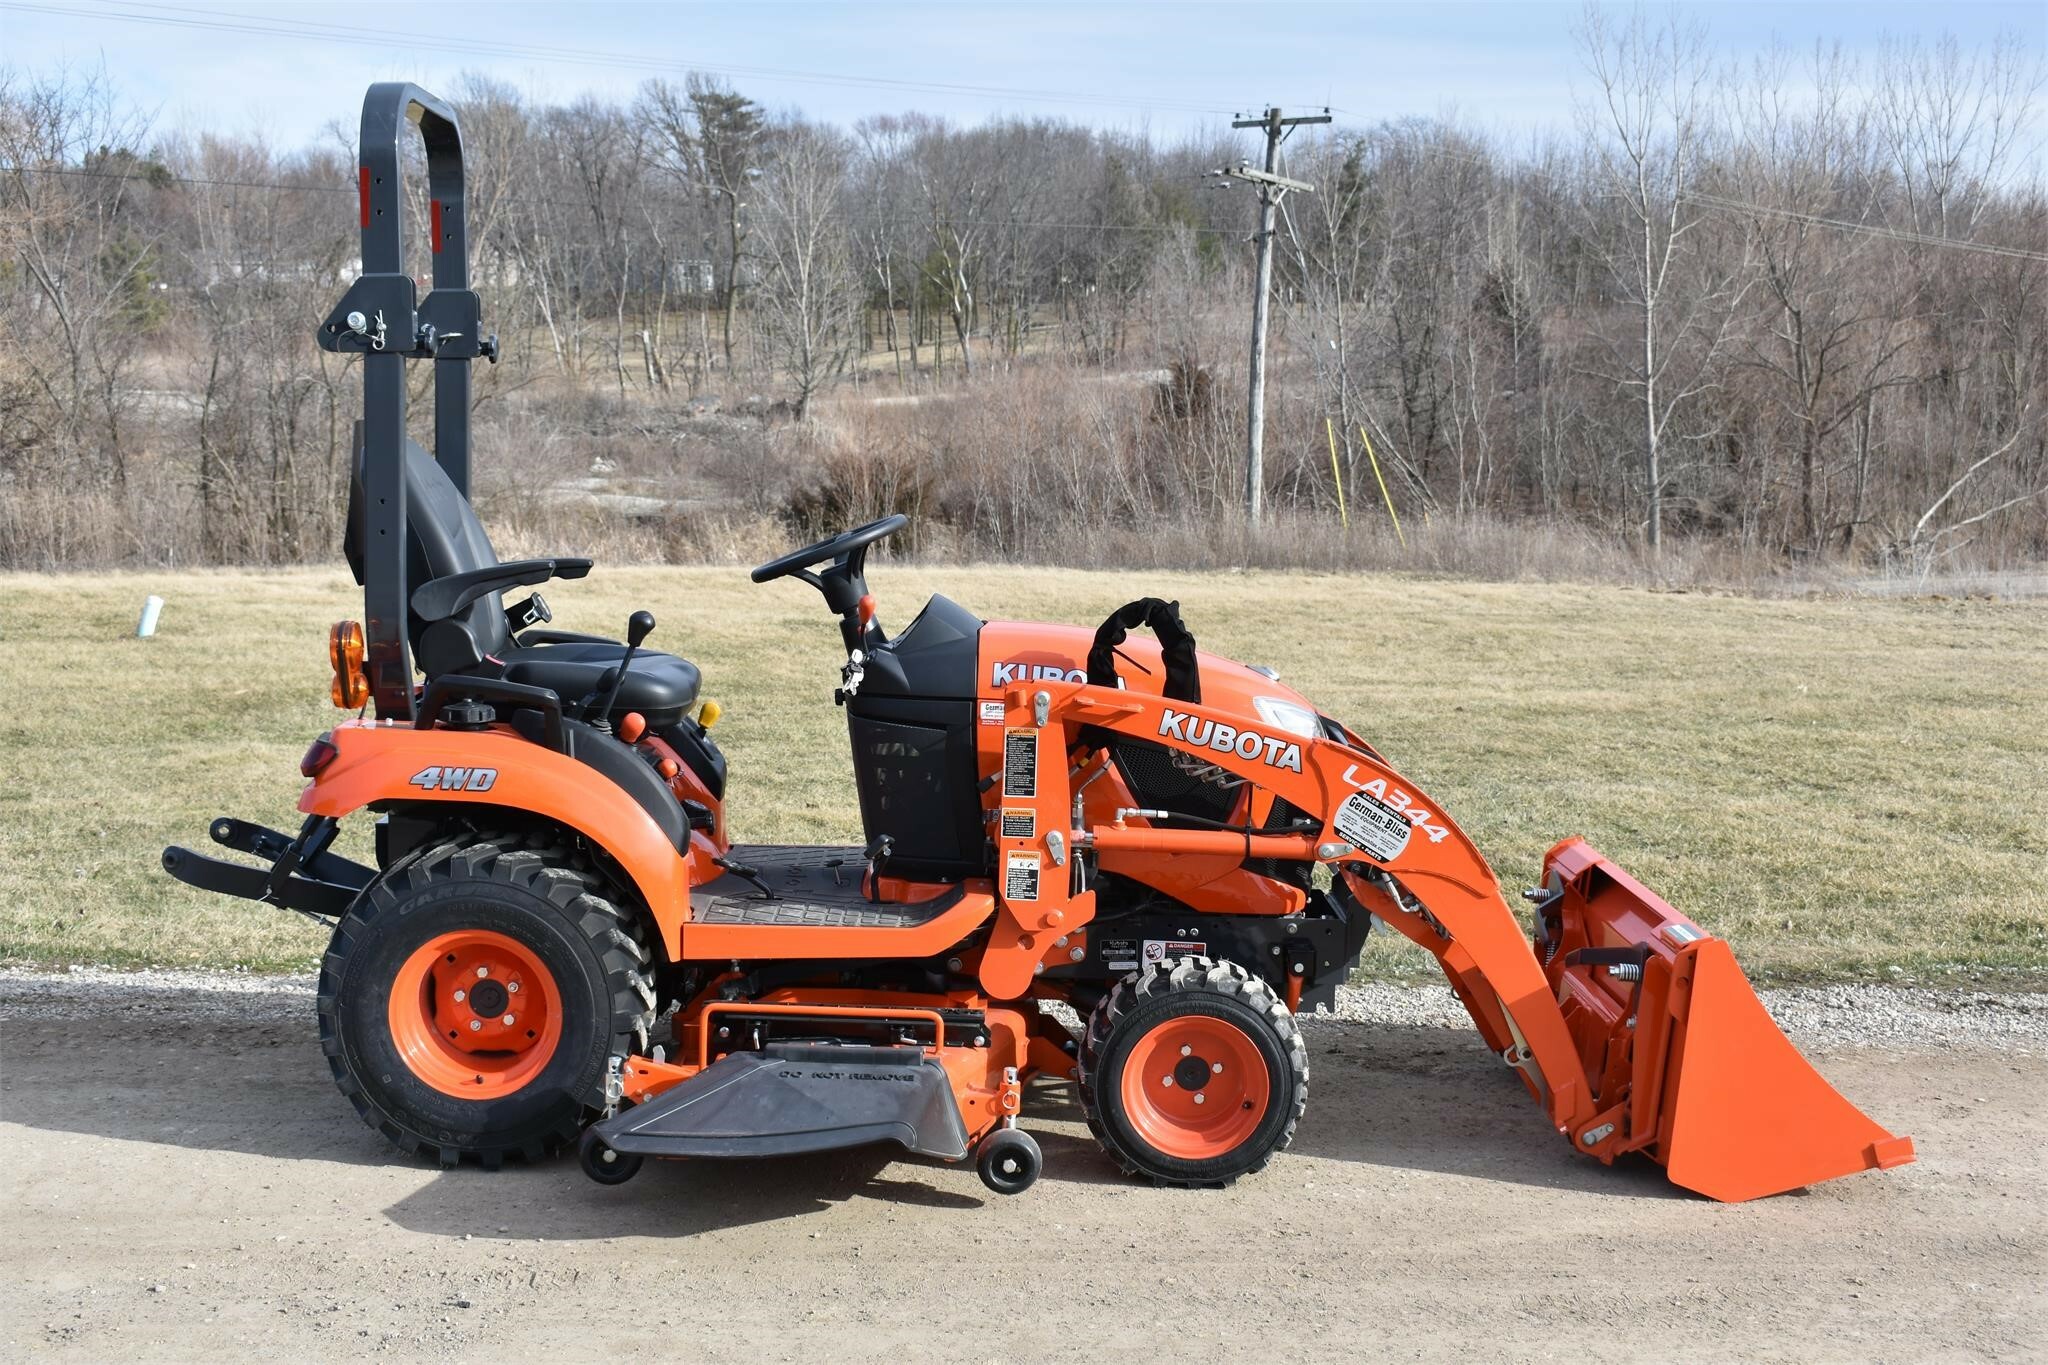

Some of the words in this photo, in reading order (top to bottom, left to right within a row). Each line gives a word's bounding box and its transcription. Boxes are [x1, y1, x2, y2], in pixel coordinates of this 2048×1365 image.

[1158, 708, 1303, 774] KUBOTA
[409, 765, 498, 792] 4WD
[1342, 764, 1450, 843] LA344
[1348, 796, 1408, 839] German-Bliss
[1362, 793, 1380, 806] SALES
[1383, 805, 1407, 823] RENTALS
[1359, 815, 1388, 835] EQUIPMENT
[1338, 831, 1362, 848] SERVICE
[1364, 848, 1382, 861] PARTS
